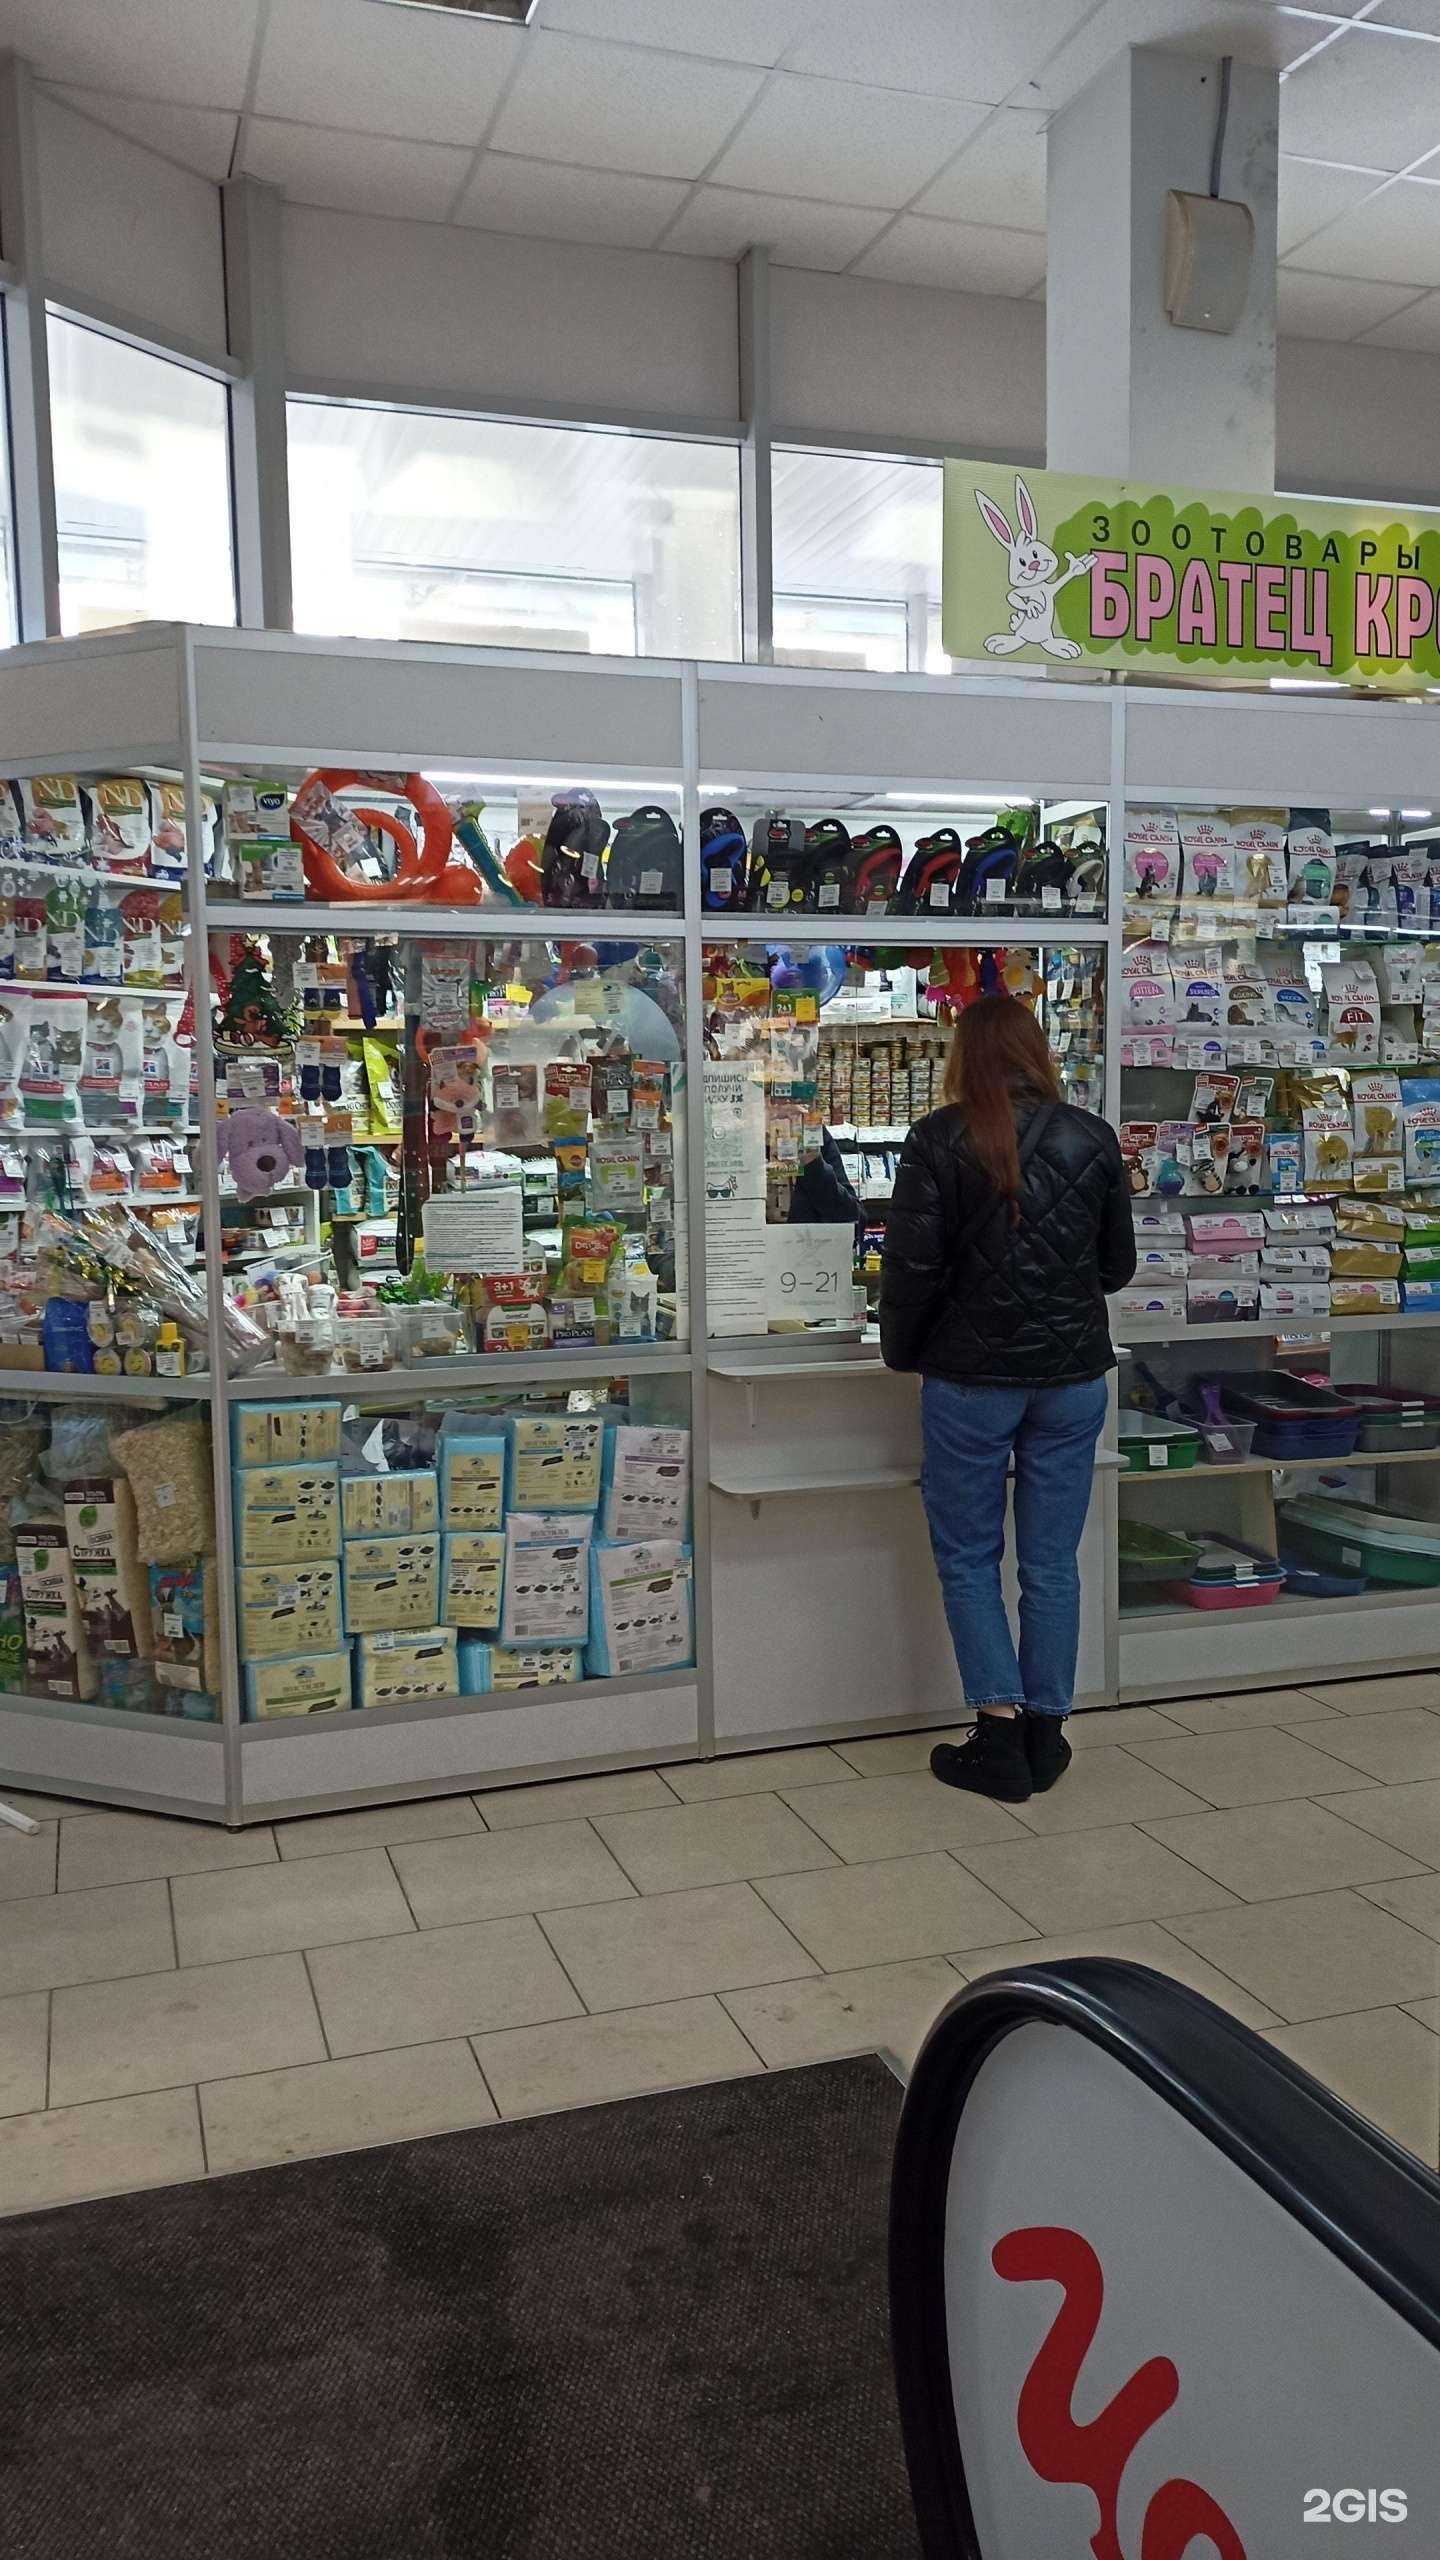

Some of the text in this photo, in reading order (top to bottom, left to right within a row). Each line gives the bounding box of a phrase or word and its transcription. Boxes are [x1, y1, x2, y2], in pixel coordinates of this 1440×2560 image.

[1092, 515, 1420, 570] ЗООТОВАРЫ
[1089, 549, 1440, 667] БРАТЕЦ КР
[1347, 1012, 1365, 1021] FIT
[493, 1281, 514, 1291] 3+1
[780, 1271, 837, 1294] 9-21
